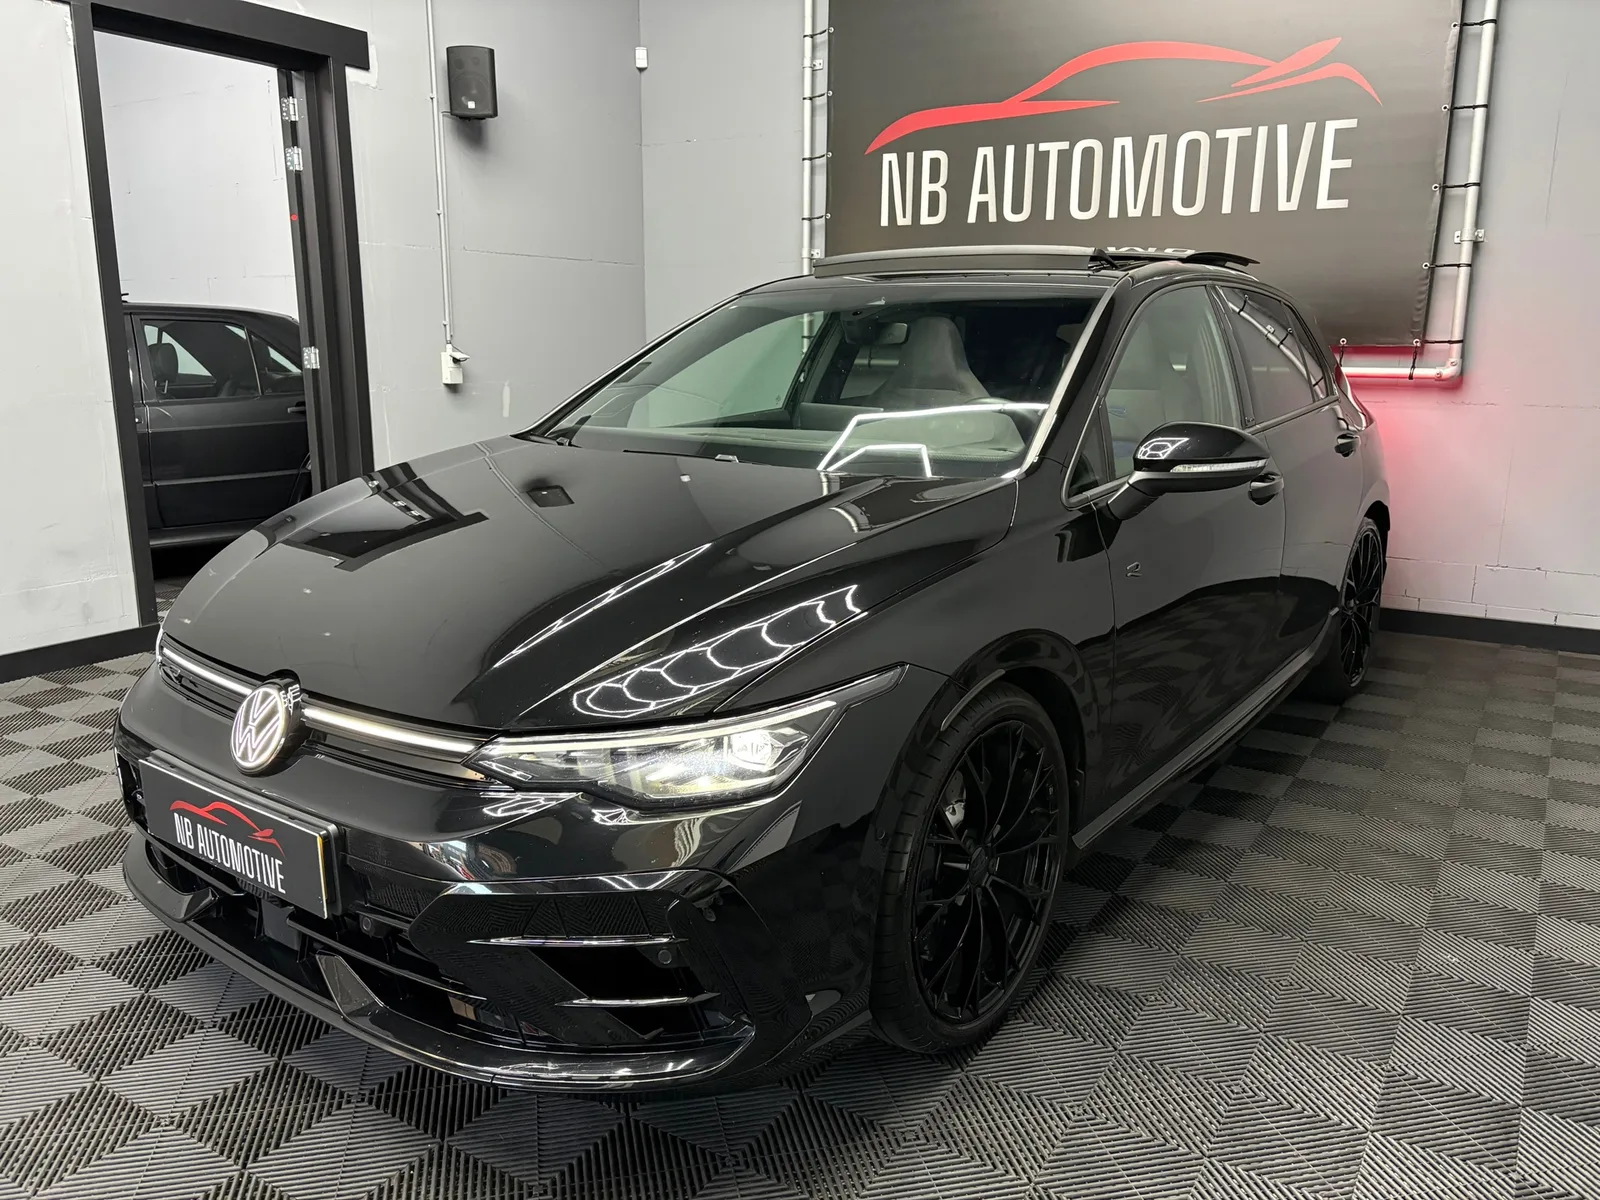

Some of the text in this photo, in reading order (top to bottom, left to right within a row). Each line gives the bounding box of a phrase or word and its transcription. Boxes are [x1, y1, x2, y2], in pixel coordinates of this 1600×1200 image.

[879, 117, 1359, 227] NB AUTOMOTIVE
[173, 812, 286, 894] NB AUTOMOTIVE
